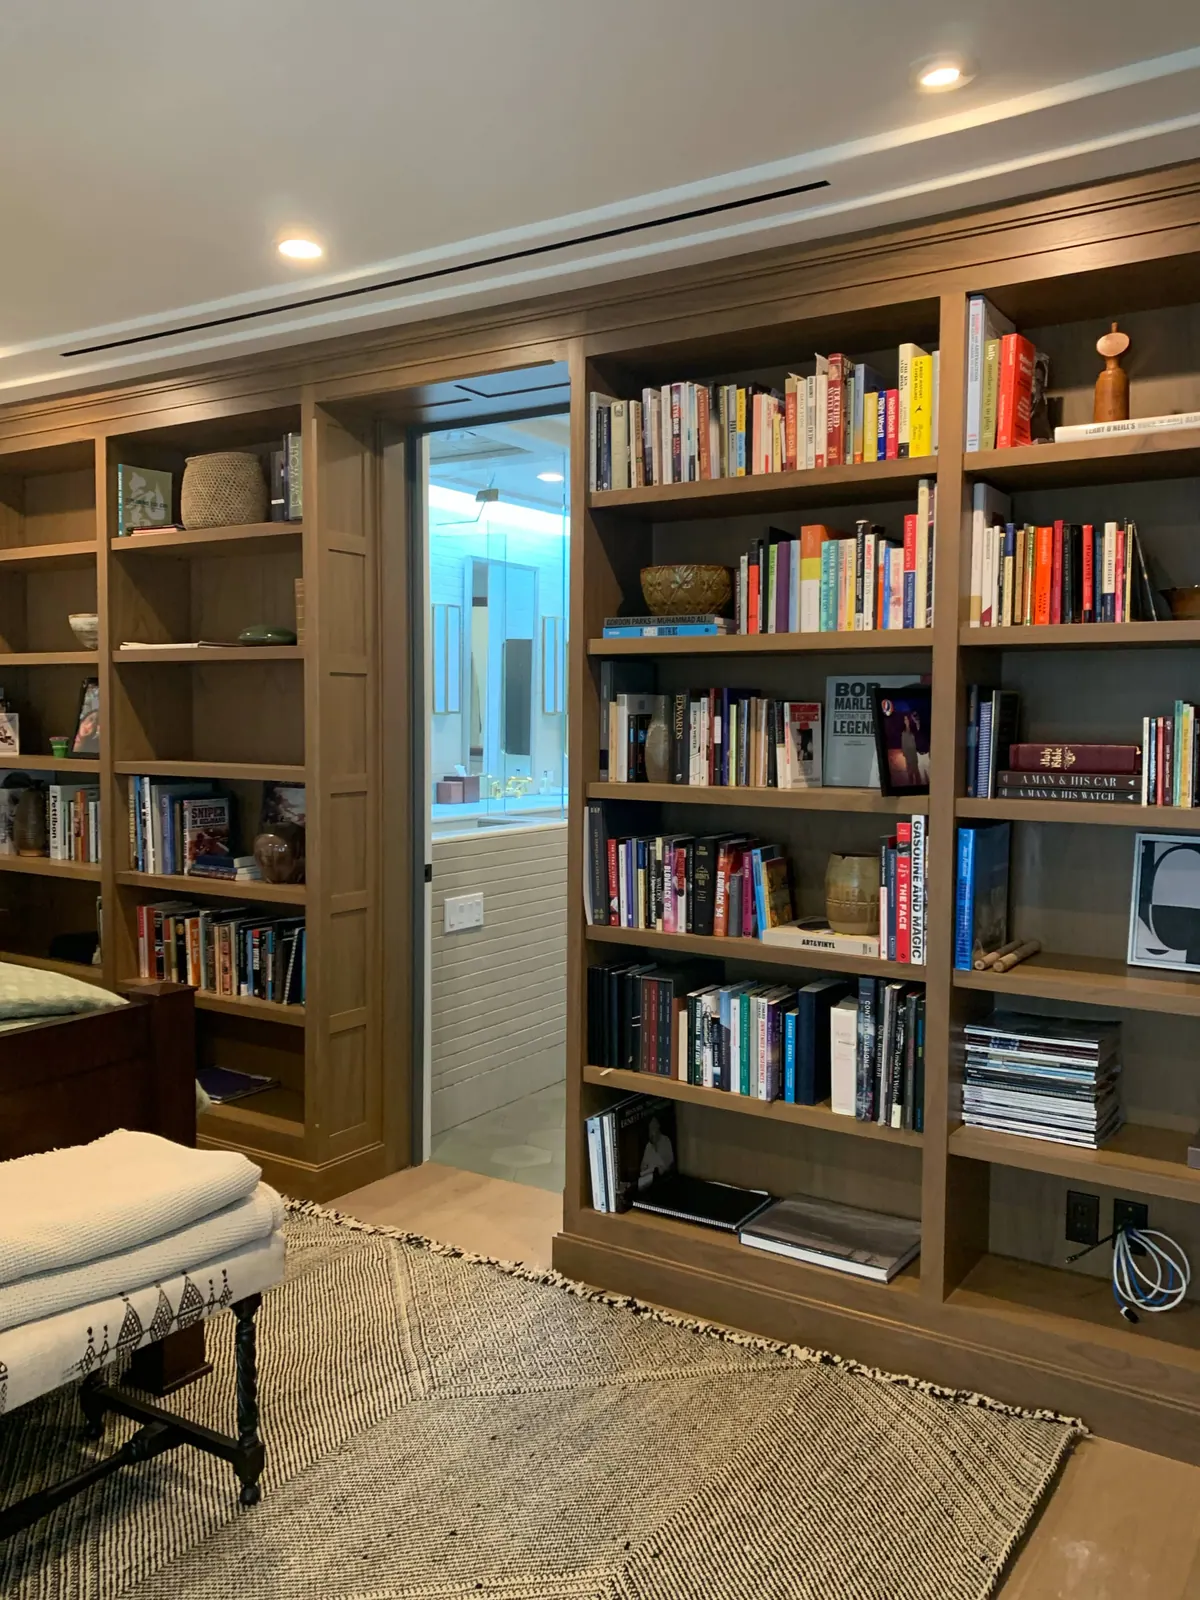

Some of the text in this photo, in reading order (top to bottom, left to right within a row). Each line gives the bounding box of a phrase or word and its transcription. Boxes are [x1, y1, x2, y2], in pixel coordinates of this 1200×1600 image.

[906, 520, 914, 548] Michael
[606, 618, 630, 626] GORDON
[632, 617, 652, 625] PARKS
[656, 616, 696, 624] MUHAMMAD
[834, 697, 872, 710] MARLE
[675, 694, 683, 740] EDWARDS
[1022, 775, 1116, 787] A MAN & HIS CAR
[1028, 790, 1048, 798] MAN
[1061, 791, 1078, 799] HIS
[1081, 792, 1115, 800] WATCH
[716, 871, 725, 905] BLOWBACK
[912, 820, 922, 959] GASOLINE AND MAGIC
[802, 939, 836, 949] ART&VINYL
[863, 1000, 871, 1040] CONTESTED
